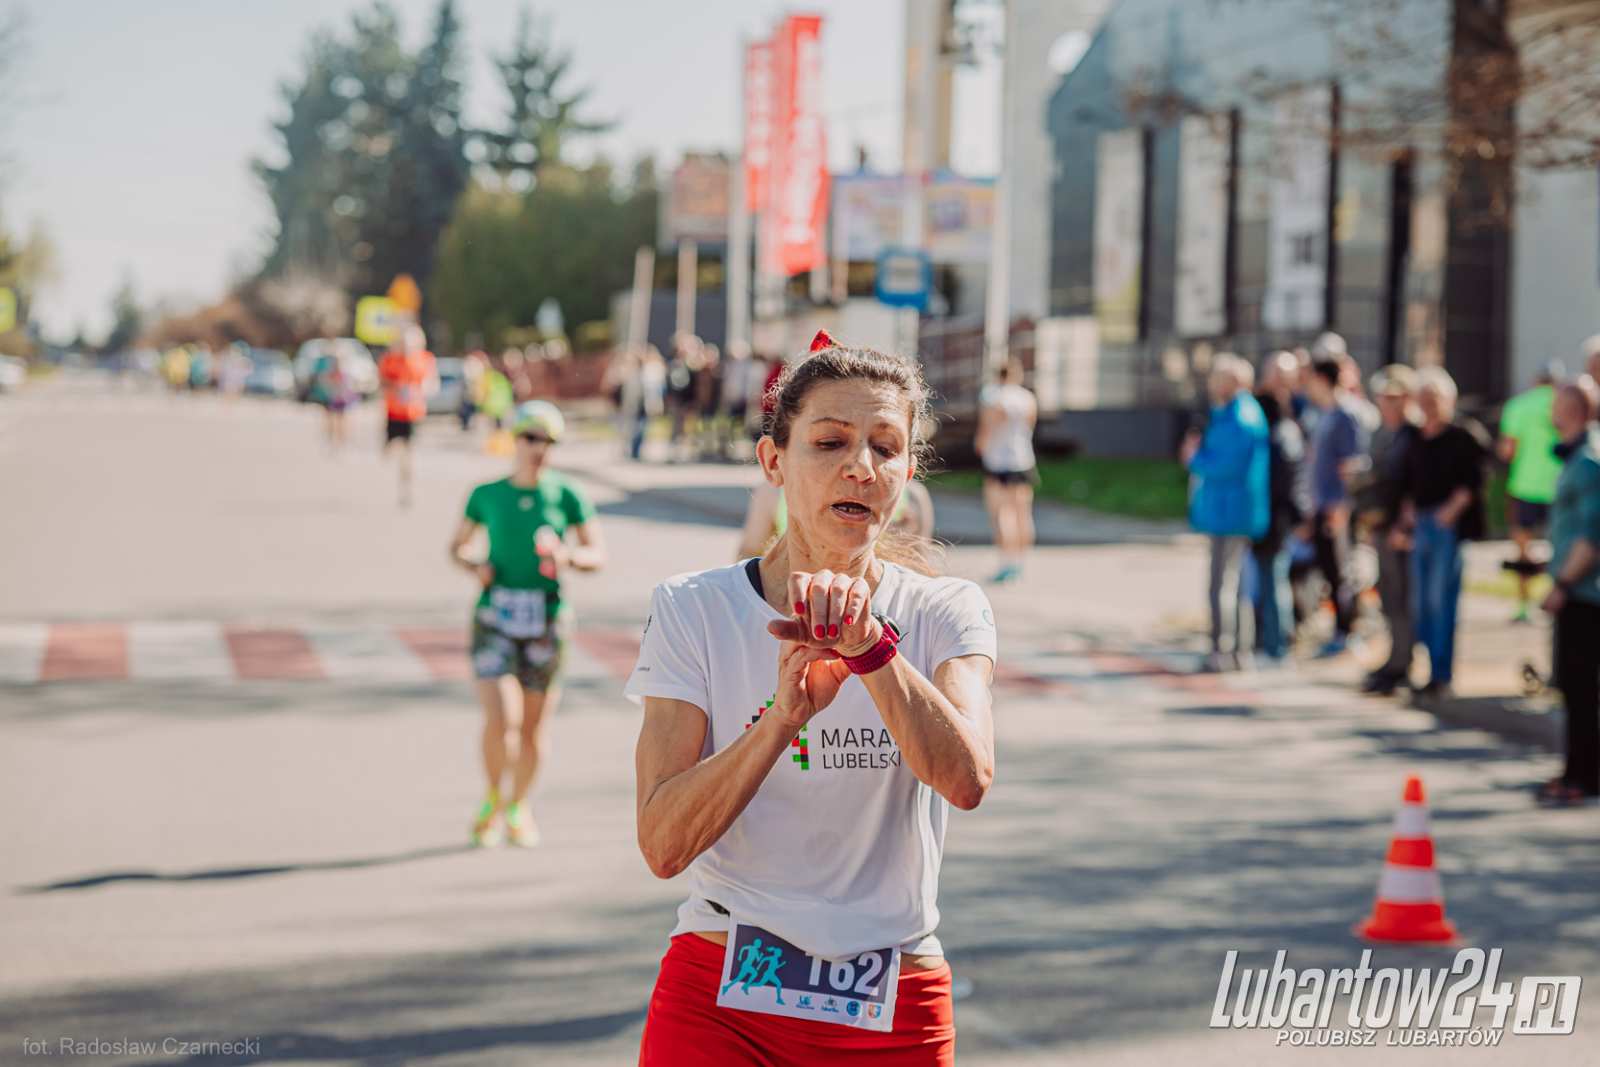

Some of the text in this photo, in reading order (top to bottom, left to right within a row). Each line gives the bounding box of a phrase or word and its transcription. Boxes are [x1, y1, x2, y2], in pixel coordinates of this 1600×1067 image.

[821, 728, 897, 748] MARA
[822, 750, 901, 769] LUBELSKI
[805, 951, 883, 997] 162
